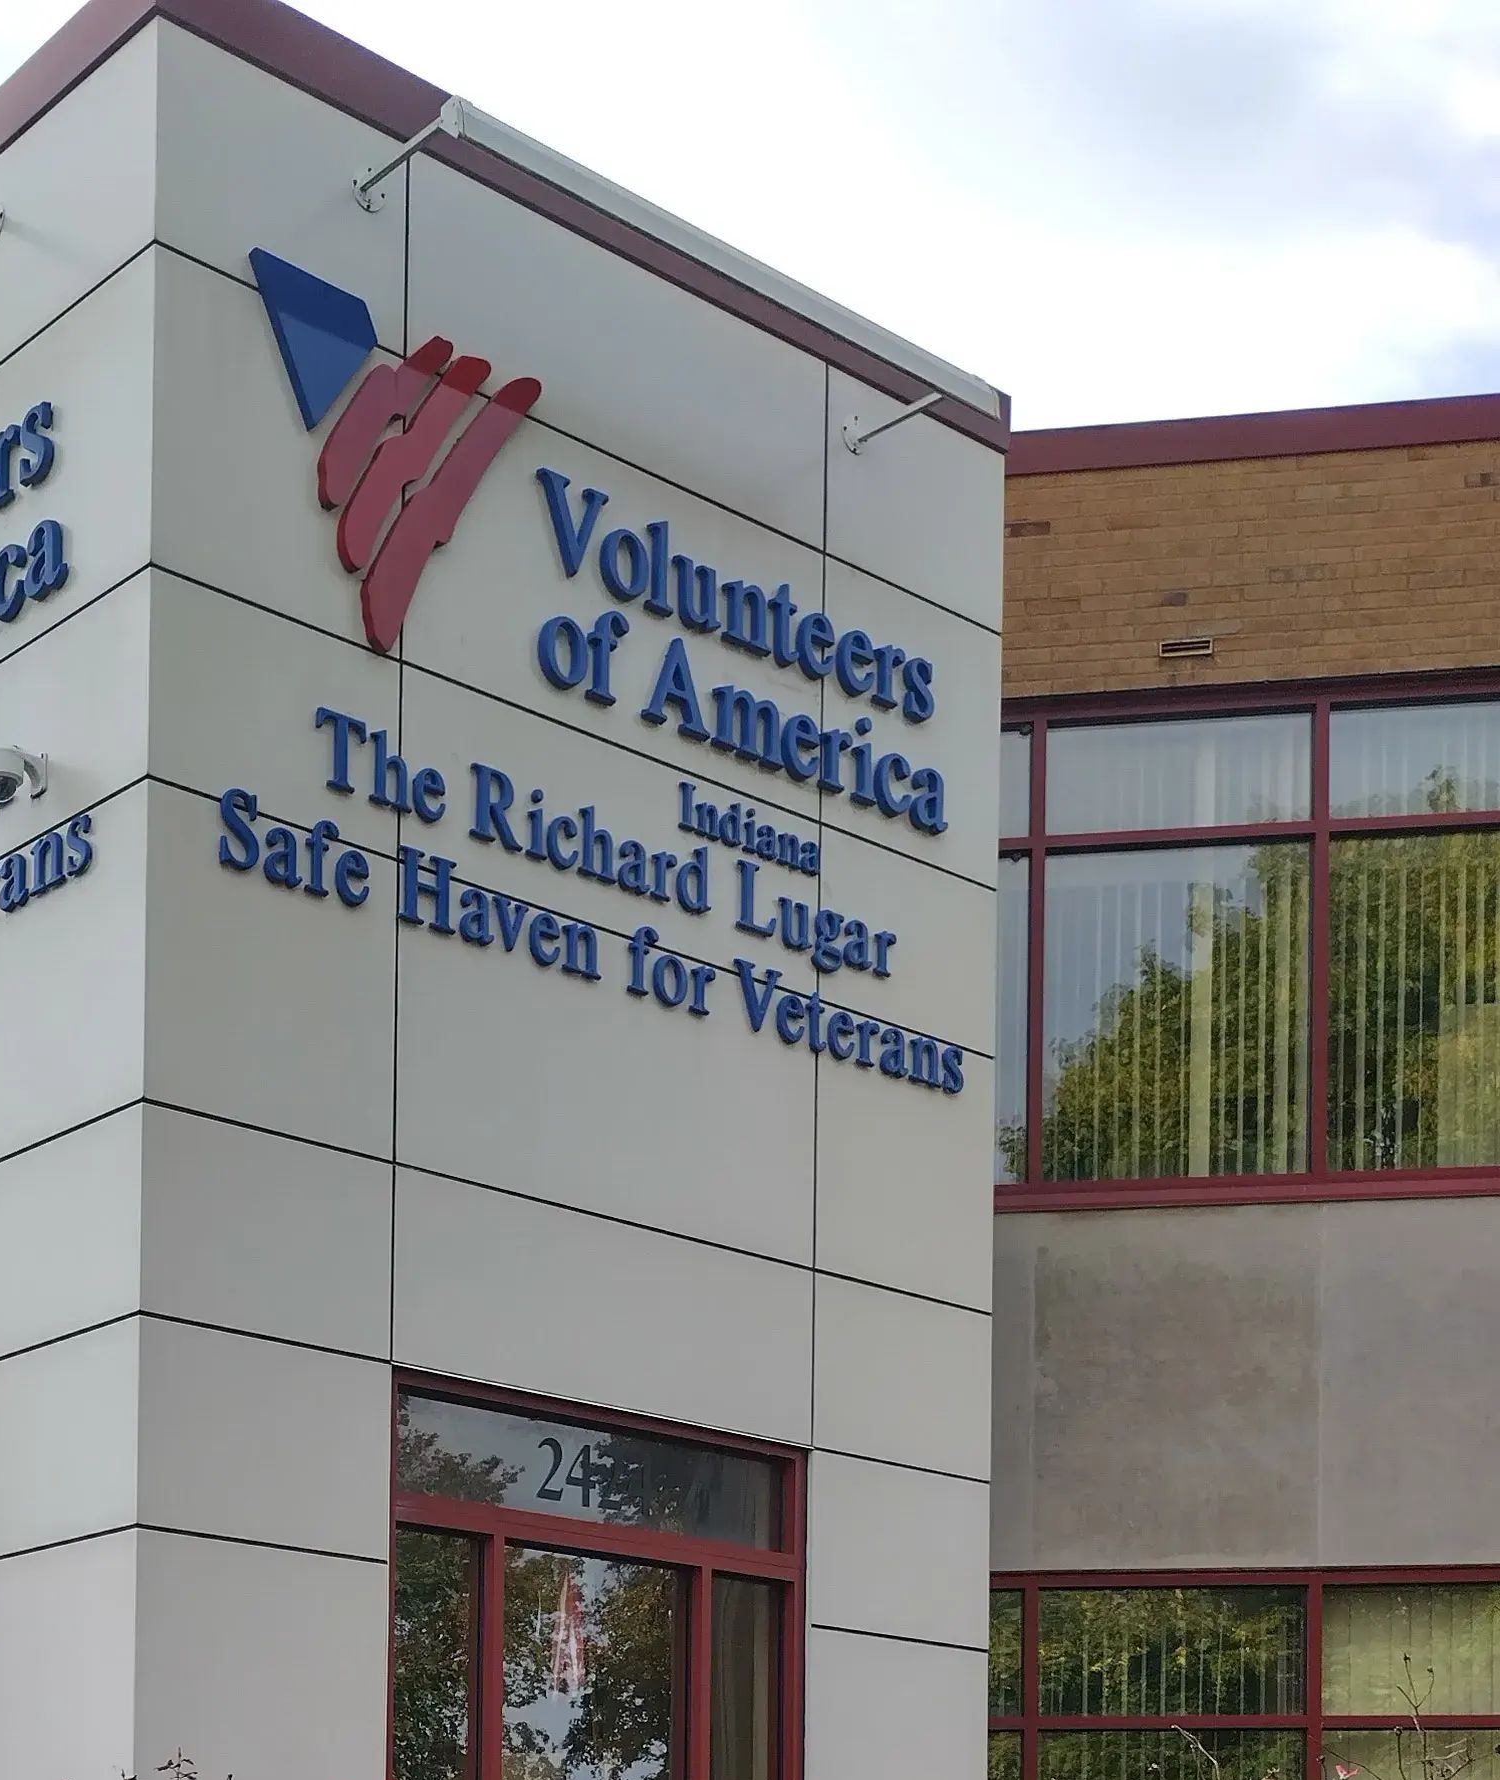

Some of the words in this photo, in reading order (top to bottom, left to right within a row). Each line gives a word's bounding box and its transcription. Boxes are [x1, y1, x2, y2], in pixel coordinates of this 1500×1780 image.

[535, 465, 937, 721] Volunteers
[314, 705, 447, 822] The
[468, 762, 711, 913] Richard
[735, 858, 897, 978] Lugar
[536, 609, 629, 704] of
[640, 635, 948, 834] America
[678, 780, 821, 875] Indiana
[218, 787, 370, 907] Safe
[397, 845, 602, 982] Haven
[627, 925, 716, 1016] for
[733, 956, 965, 1095] Veterans
